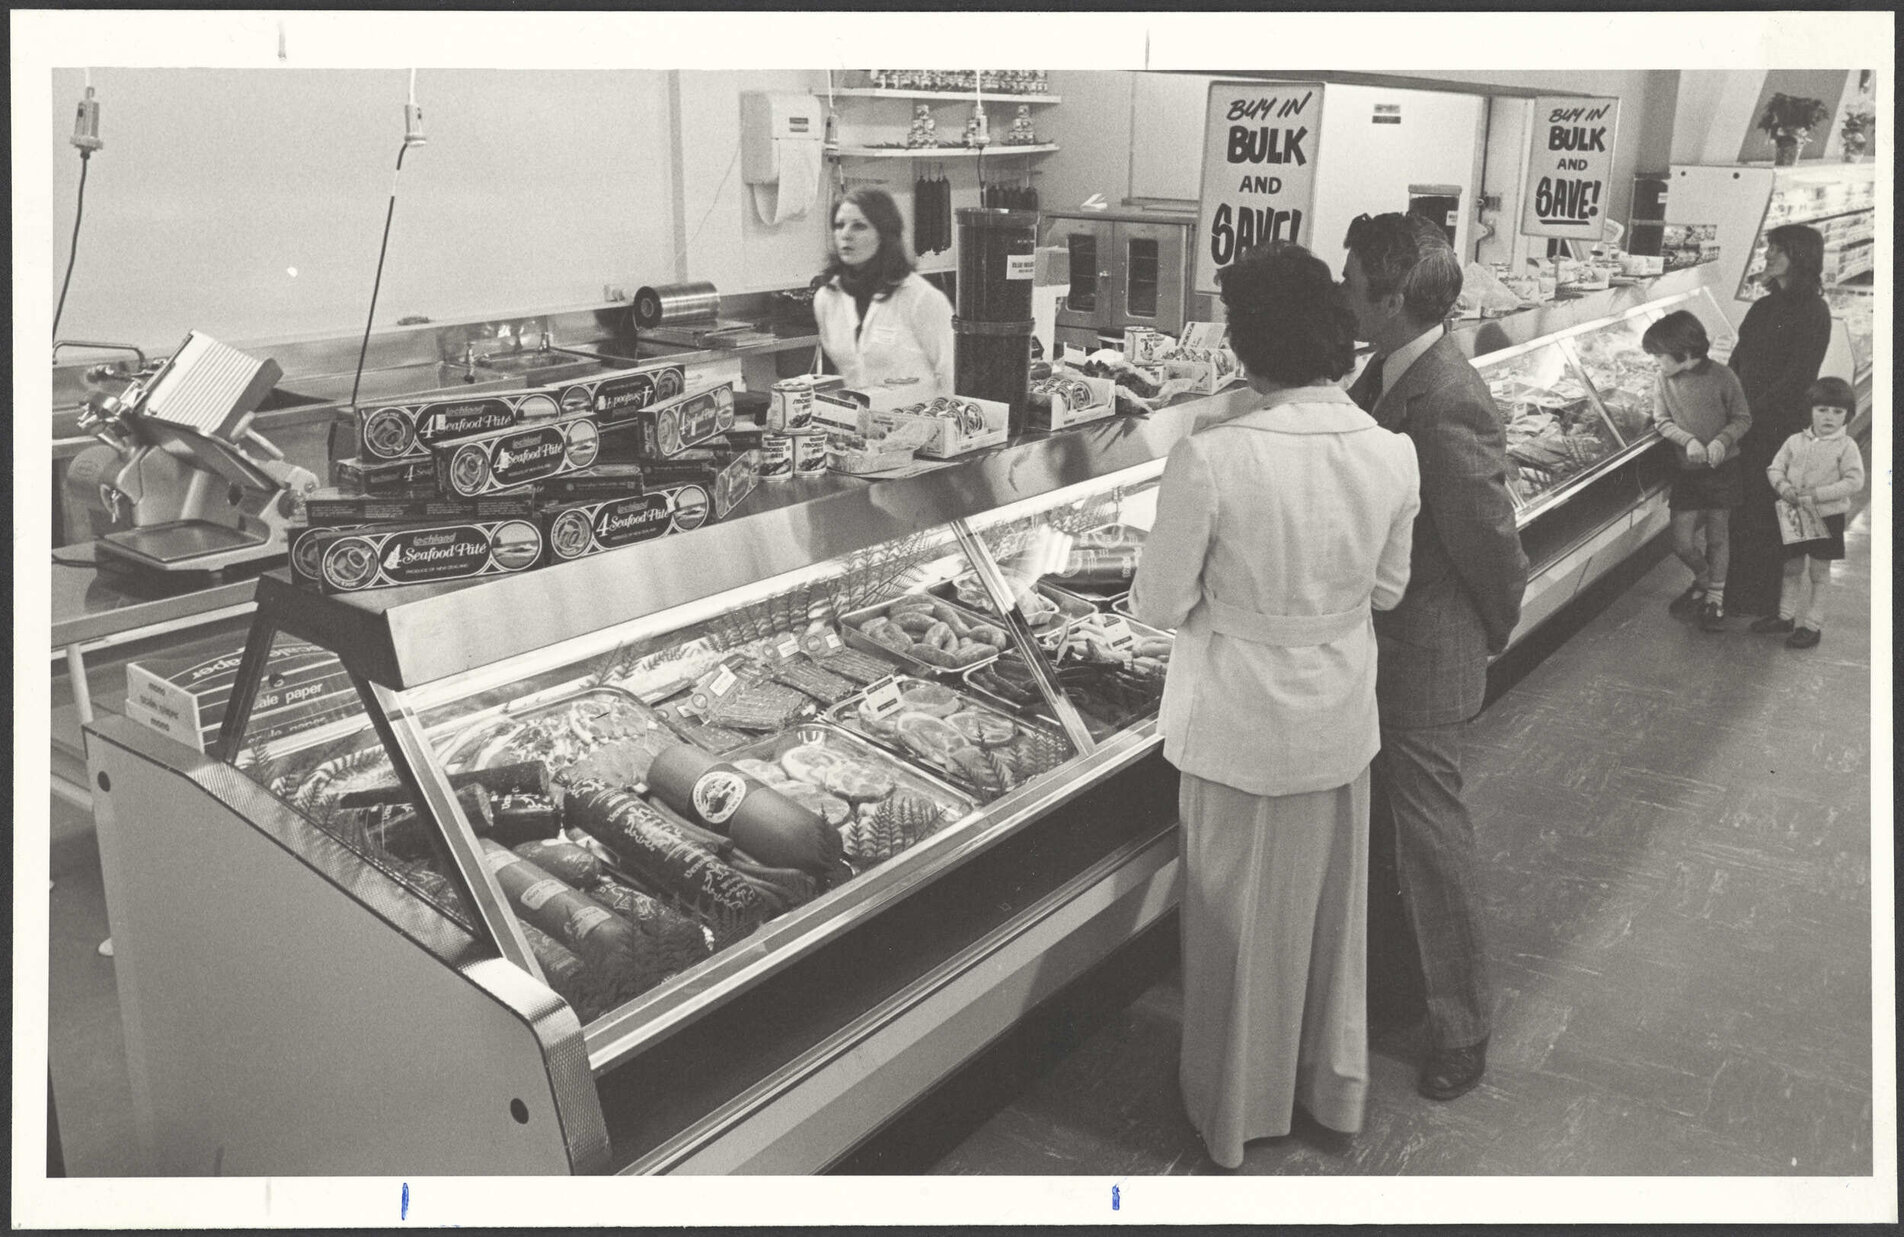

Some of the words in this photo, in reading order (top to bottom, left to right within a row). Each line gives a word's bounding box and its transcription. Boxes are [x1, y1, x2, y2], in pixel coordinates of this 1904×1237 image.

[1226, 97, 1277, 121] BUY
[1277, 91, 1313, 119] IN
[1548, 107, 1586, 123] BUY
[1584, 104, 1611, 121] IN
[1227, 125, 1308, 167] BULK
[1548, 125, 1606, 153] BULK
[1557, 158, 1588, 171] AND
[1239, 175, 1283, 195] AND
[1535, 176, 1602, 220] SAVE!
[419, 414, 435, 439] 4
[596, 512, 610, 537] 4
[608, 511, 647, 532] Seafood
[402, 544, 455, 565] Seafood
[454, 542, 487, 557] Pâté
[193, 659, 243, 680] aper
[285, 683, 323, 704] paper
